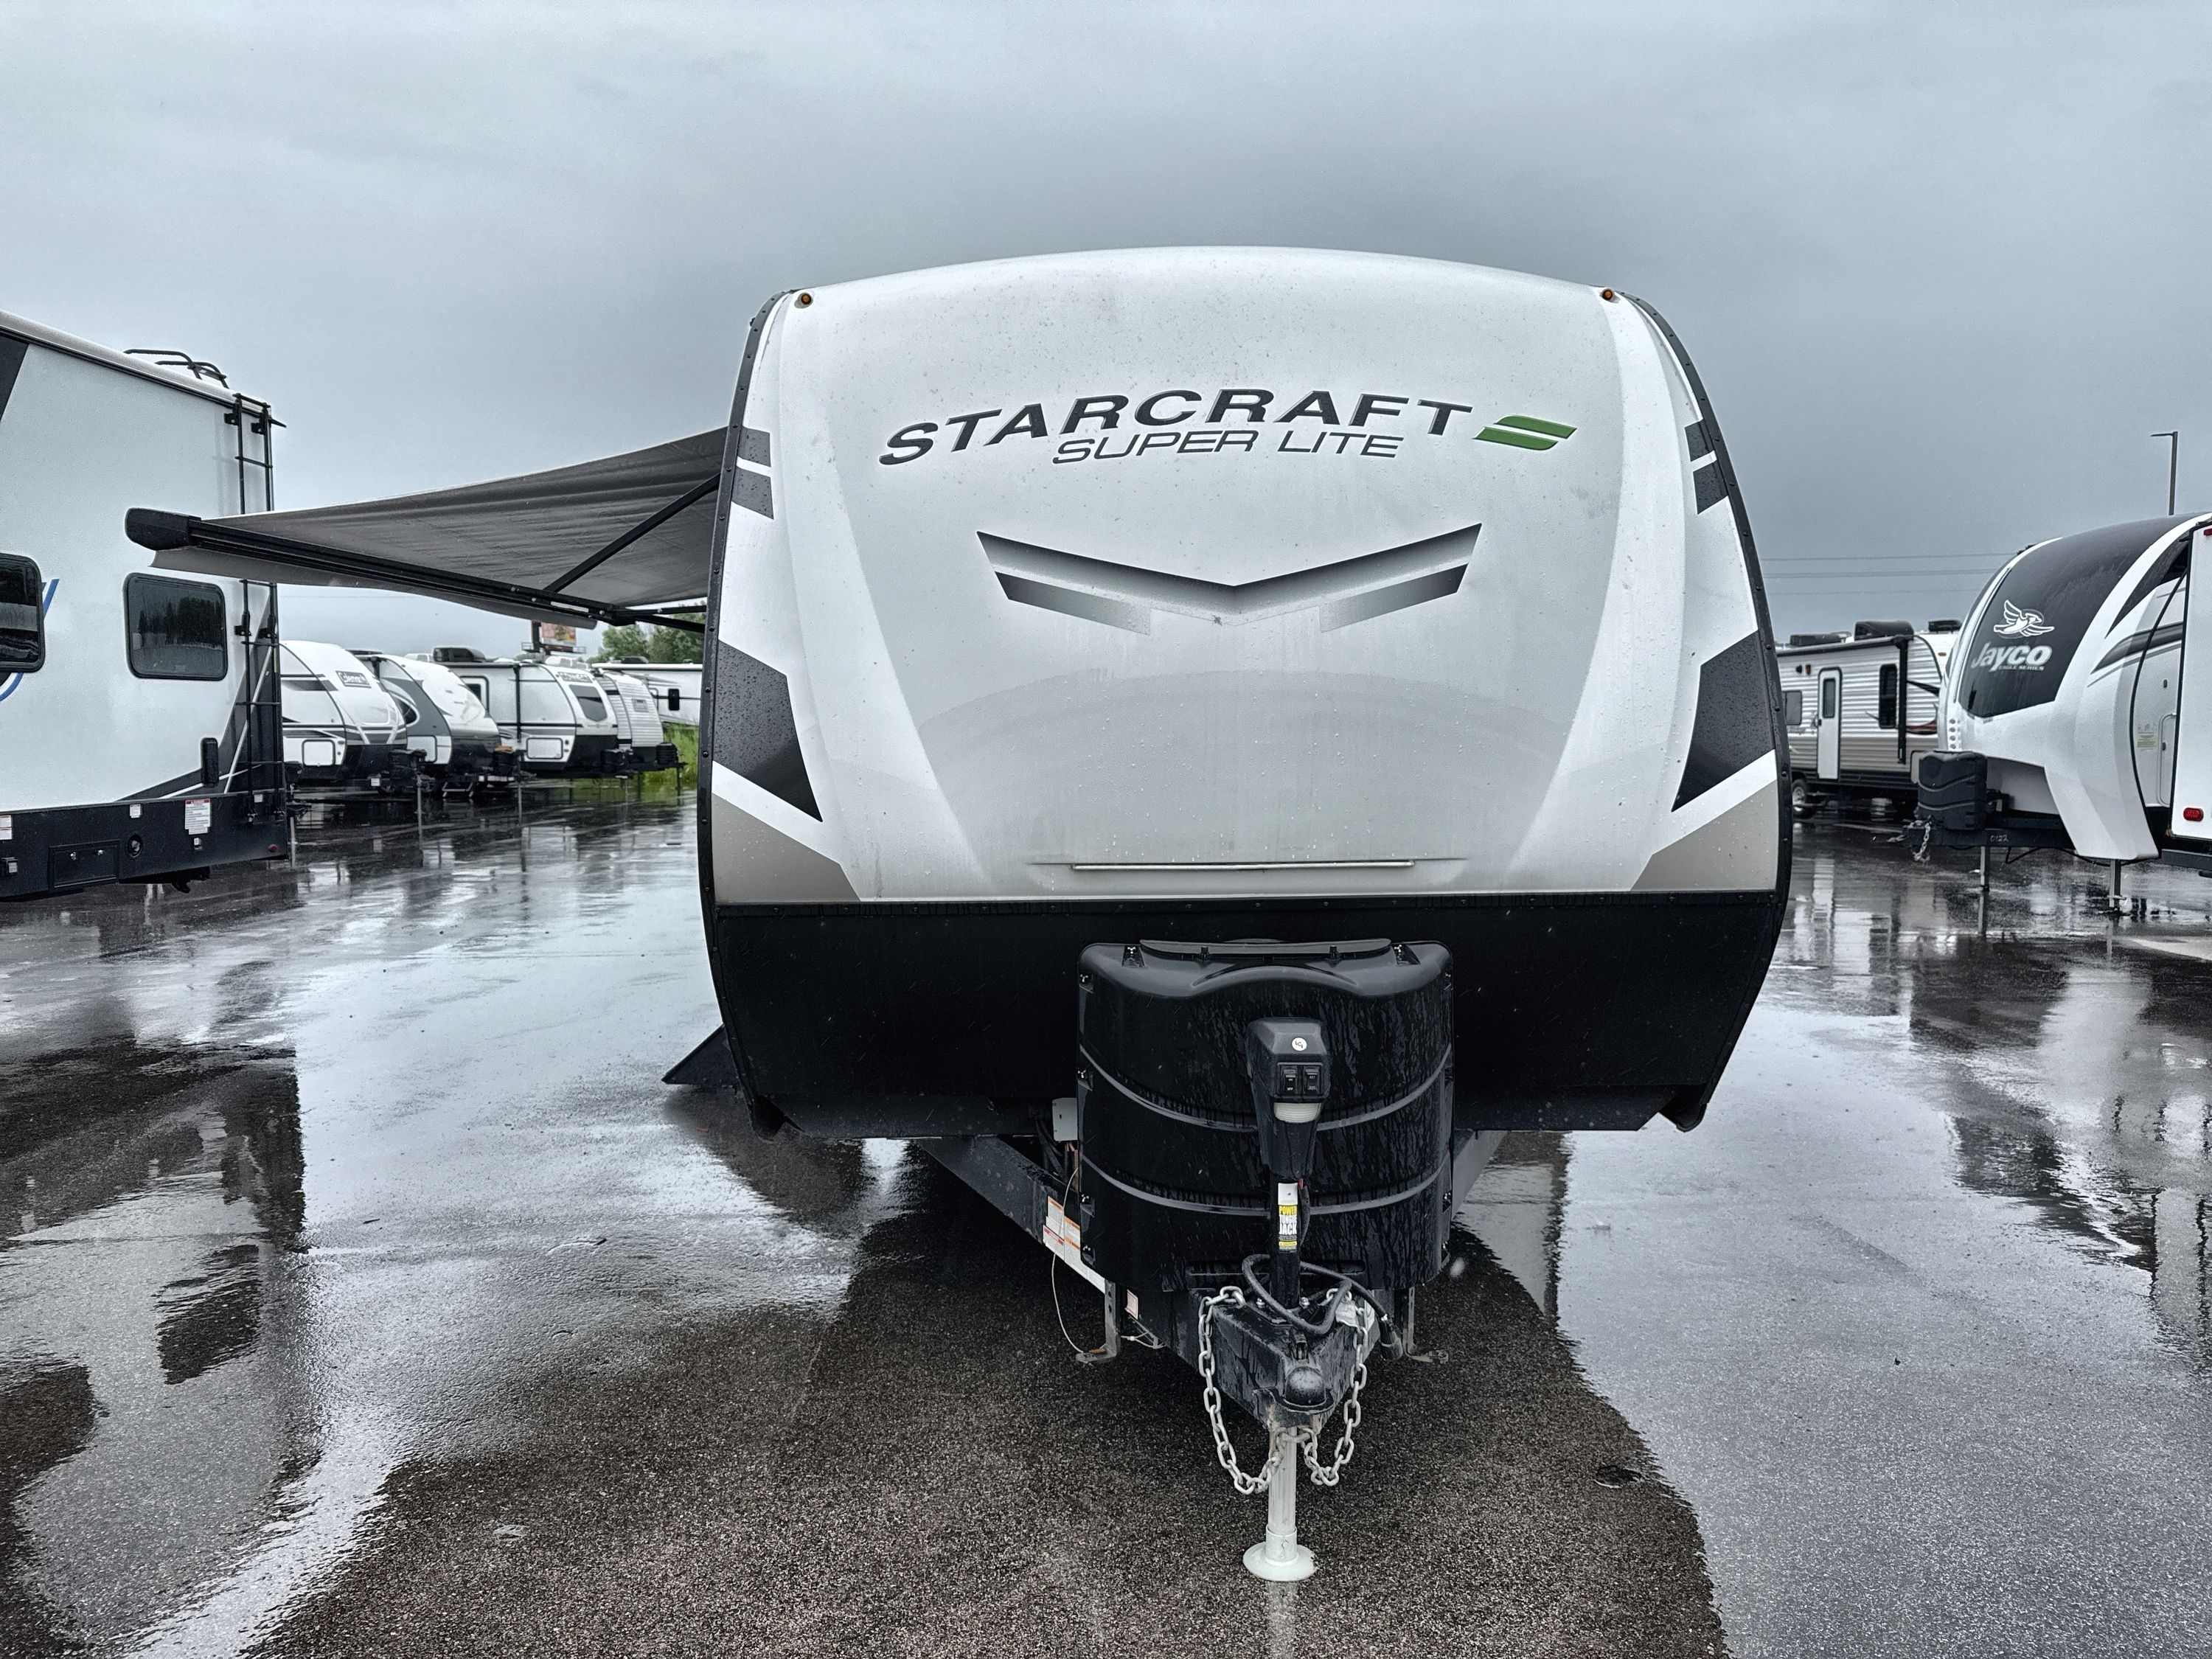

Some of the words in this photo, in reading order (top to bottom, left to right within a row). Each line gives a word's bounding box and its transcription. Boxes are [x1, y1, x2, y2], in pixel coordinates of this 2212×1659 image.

[880, 389, 1473, 465] STARCRAFT
[1052, 430, 1259, 465] SUPER
[1277, 430, 1404, 458] LITE
[1971, 642, 2053, 672] Jayco
[1279, 1224, 1297, 1235] JACK
